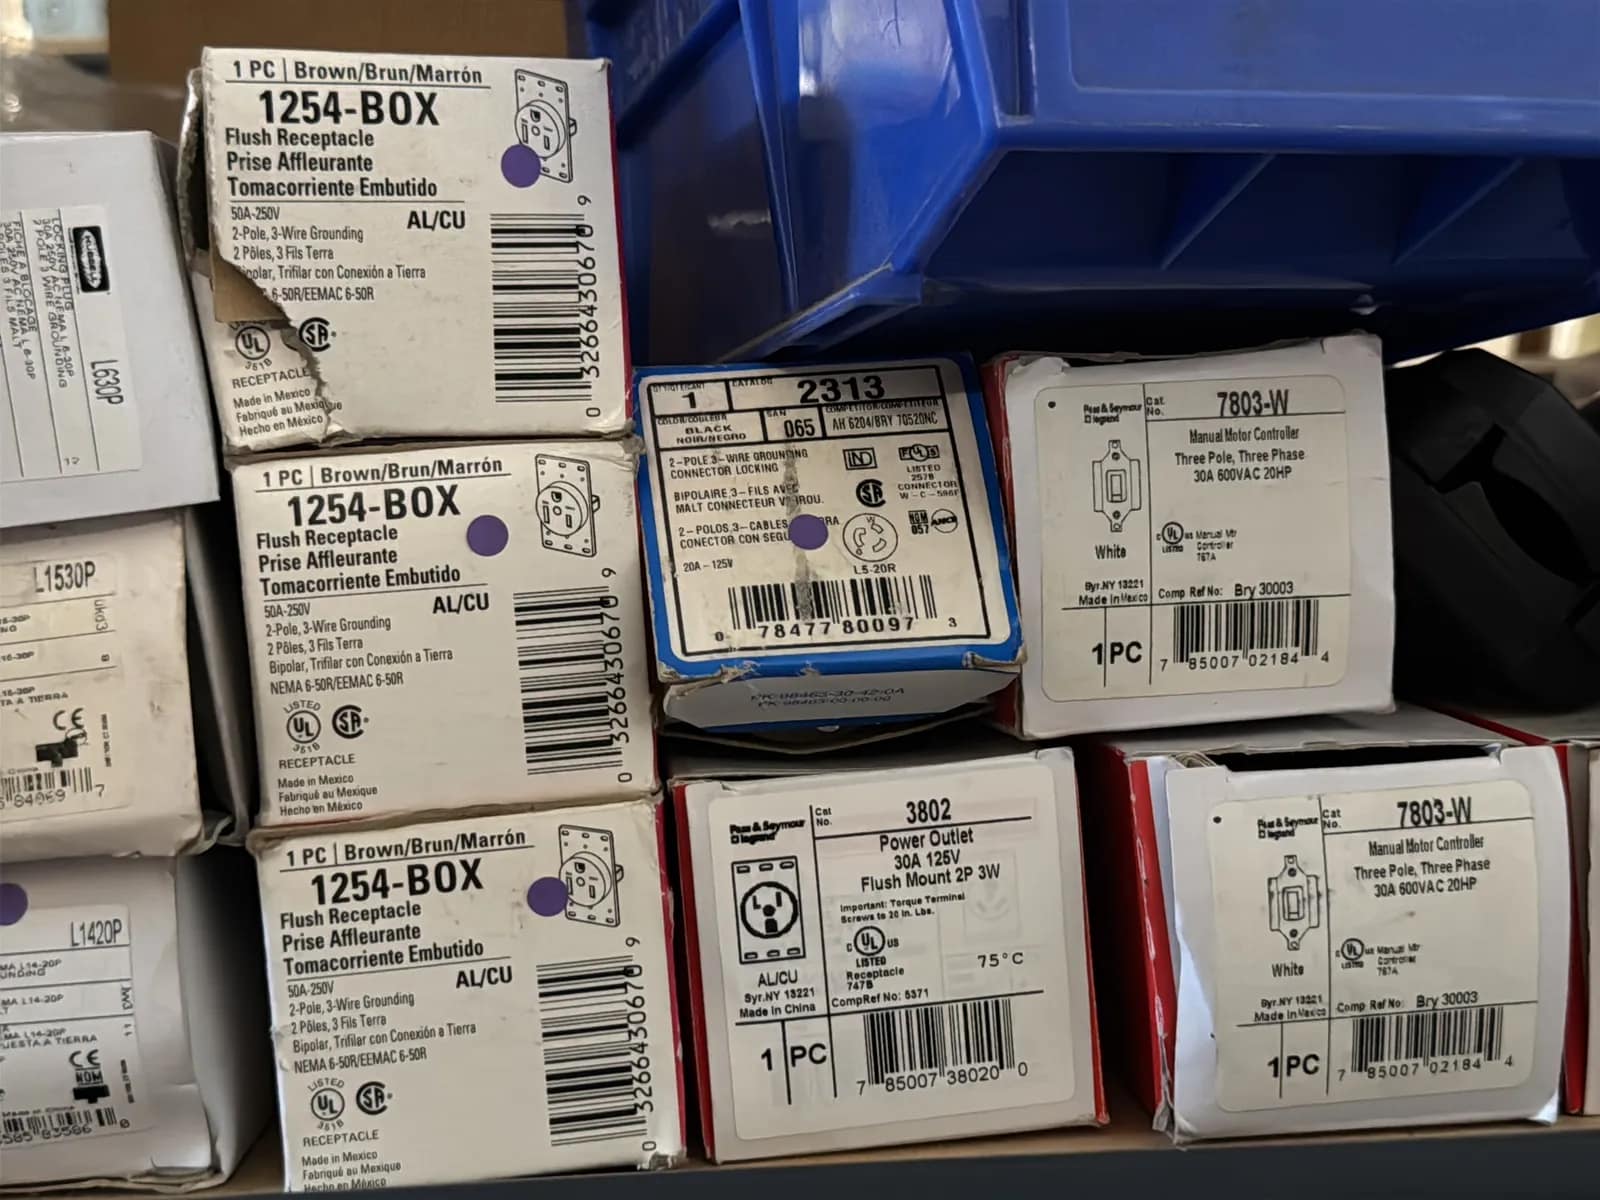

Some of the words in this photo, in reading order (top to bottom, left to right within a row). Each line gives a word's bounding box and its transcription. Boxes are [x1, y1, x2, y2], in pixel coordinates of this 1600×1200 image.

[234, 61, 241, 77] 1
[250, 61, 275, 78] PC
[295, 62, 482, 84] Brown/Brun/Marrón
[260, 90, 440, 125] 1254-BOX
[226, 129, 272, 146] Flush
[277, 129, 374, 148] Receptacle
[227, 153, 272, 170] Prise
[278, 153, 373, 172] Affleurante
[228, 178, 354, 197] Tomacorriente
[360, 179, 437, 197] Embutido
[577, 195, 591, 204] 9
[231, 207, 280, 221] 50A-250V
[407, 211, 466, 230] AL/CU
[232, 227, 269, 242] 2-Pole,
[272, 228, 306, 242] 3-Wire
[310, 228, 363, 243] Grounding
[91, 360, 123, 404] L630P
[797, 376, 886, 403] 2313
[682, 392, 696, 408] 1
[1217, 389, 1289, 417] 7803-W
[586, 407, 600, 417] 0
[685, 425, 732, 434] BLACK
[784, 419, 814, 438] 065
[833, 418, 845, 430] AH
[850, 416, 892, 429] 6204/BRY
[1190, 430, 1223, 444] Manual
[1225, 429, 1251, 443] Motor
[1254, 427, 1299, 441] Controller
[1175, 453, 1205, 466] Three
[1208, 452, 1235, 465] Pole,
[1239, 450, 1268, 463] Three
[1271, 449, 1304, 461] Phase
[263, 472, 271, 487] 1
[279, 470, 303, 486] PC
[321, 458, 502, 484] Brown/Brun/Marrón
[671, 468, 732, 479] CONNECTOR
[736, 463, 778, 475] LOCKING
[907, 464, 941, 473] LISTED
[1194, 470, 1214, 483] 30A
[1217, 468, 1260, 482] 600VAC
[1264, 467, 1292, 480] 20HP
[287, 485, 461, 527] 1254-BOX
[676, 503, 702, 513] MALT
[708, 496, 775, 511] CONNECTEUR
[257, 533, 300, 549] Flush
[306, 526, 398, 547] Receptacle
[680, 535, 734, 549] CONECTOR
[739, 534, 759, 545] CON
[259, 555, 301, 572] Prise
[306, 549, 397, 570] Affleurante
[1095, 545, 1126, 560] White
[33, 561, 95, 592] L1530P
[854, 563, 896, 575] L5-20R
[260, 572, 380, 596] Tomacorriente
[386, 566, 460, 587] Embutido
[1234, 584, 1255, 600] Bry
[1259, 582, 1293, 595] 30003
[265, 603, 311, 618] 50A-250V
[433, 593, 489, 614] AL/CU
[266, 623, 300, 637] 2-Pole,
[303, 620, 337, 634] 3-Wire
[340, 617, 391, 633] Grounding
[758, 622, 831, 638] 78477
[842, 616, 914, 632] 80097
[268, 644, 274, 655] 2
[309, 640, 315, 652] 3
[318, 638, 335, 651] Fils
[337, 638, 363, 651] Terra
[1092, 643, 1103, 665] 1
[1110, 642, 1142, 664] PC
[270, 659, 308, 675] Bipolar,
[310, 655, 343, 671] Trifilar
[346, 656, 364, 669] con
[367, 651, 412, 667] Conexión
[416, 653, 421, 663] a
[424, 648, 453, 662] Tierra
[1160, 659, 1168, 671] 7
[1189, 656, 1238, 670] 85007
[1249, 652, 1299, 667] 02184
[1321, 652, 1329, 663] 4
[271, 680, 303, 695] NEMA
[305, 675, 373, 692] 6-50R/EEMAC
[375, 673, 404, 687] 6-50R
[283, 700, 321, 713] LISTED
[279, 753, 355, 769] RECEPTACLE
[278, 778, 305, 788] Made
[319, 775, 353, 785] Mexico
[906, 798, 951, 824] 3802
[1397, 797, 1472, 828] 7803-W
[345, 829, 526, 860] Brown/Brun/Marrón
[880, 833, 925, 852] Power
[930, 828, 974, 847] Outlet
[1369, 840, 1404, 856] Manual
[1406, 838, 1433, 854] Motor
[1436, 836, 1484, 852] Controller
[894, 854, 921, 870] 30A
[926, 849, 960, 867] 125V
[861, 874, 901, 892] Flush
[906, 870, 951, 889] Mount
[956, 866, 973, 882] 2P
[979, 864, 1000, 880] 3W
[1354, 865, 1386, 881] Three
[1389, 864, 1417, 879] Pole,
[1421, 861, 1453, 875] Three
[1456, 858, 1490, 872] Phase
[311, 858, 484, 906] 1254-BOX
[890, 898, 922, 908] Torque
[925, 892, 965, 904] Terminal
[281, 912, 324, 929] Flush
[329, 902, 421, 925] Receptacle
[70, 918, 123, 947] L1420P
[282, 934, 325, 952] Prise
[330, 926, 421, 948] Affleurante
[284, 950, 404, 976] Tomacorriente
[409, 942, 484, 963] Embutido
[856, 956, 886, 968] LISTED
[456, 967, 512, 989] AL/CU
[758, 971, 798, 988] AL/CU
[846, 967, 904, 981] Receptacle
[1272, 963, 1304, 977] White
[784, 987, 815, 999] 13221
[1416, 995, 1439, 1010] Bry
[1441, 991, 1478, 1005] 30003
[739, 1006, 770, 1019] Made
[785, 1003, 816, 1014] China
[761, 1048, 773, 1071] 1
[790, 1044, 827, 1067] PC
[885, 1073, 938, 1092] 85007
[947, 1065, 1000, 1085] 38020
[1368, 1064, 1419, 1079] 85007
[1430, 1060, 1481, 1073] 02184
[303, 1130, 379, 1146] RECEPTACLE
